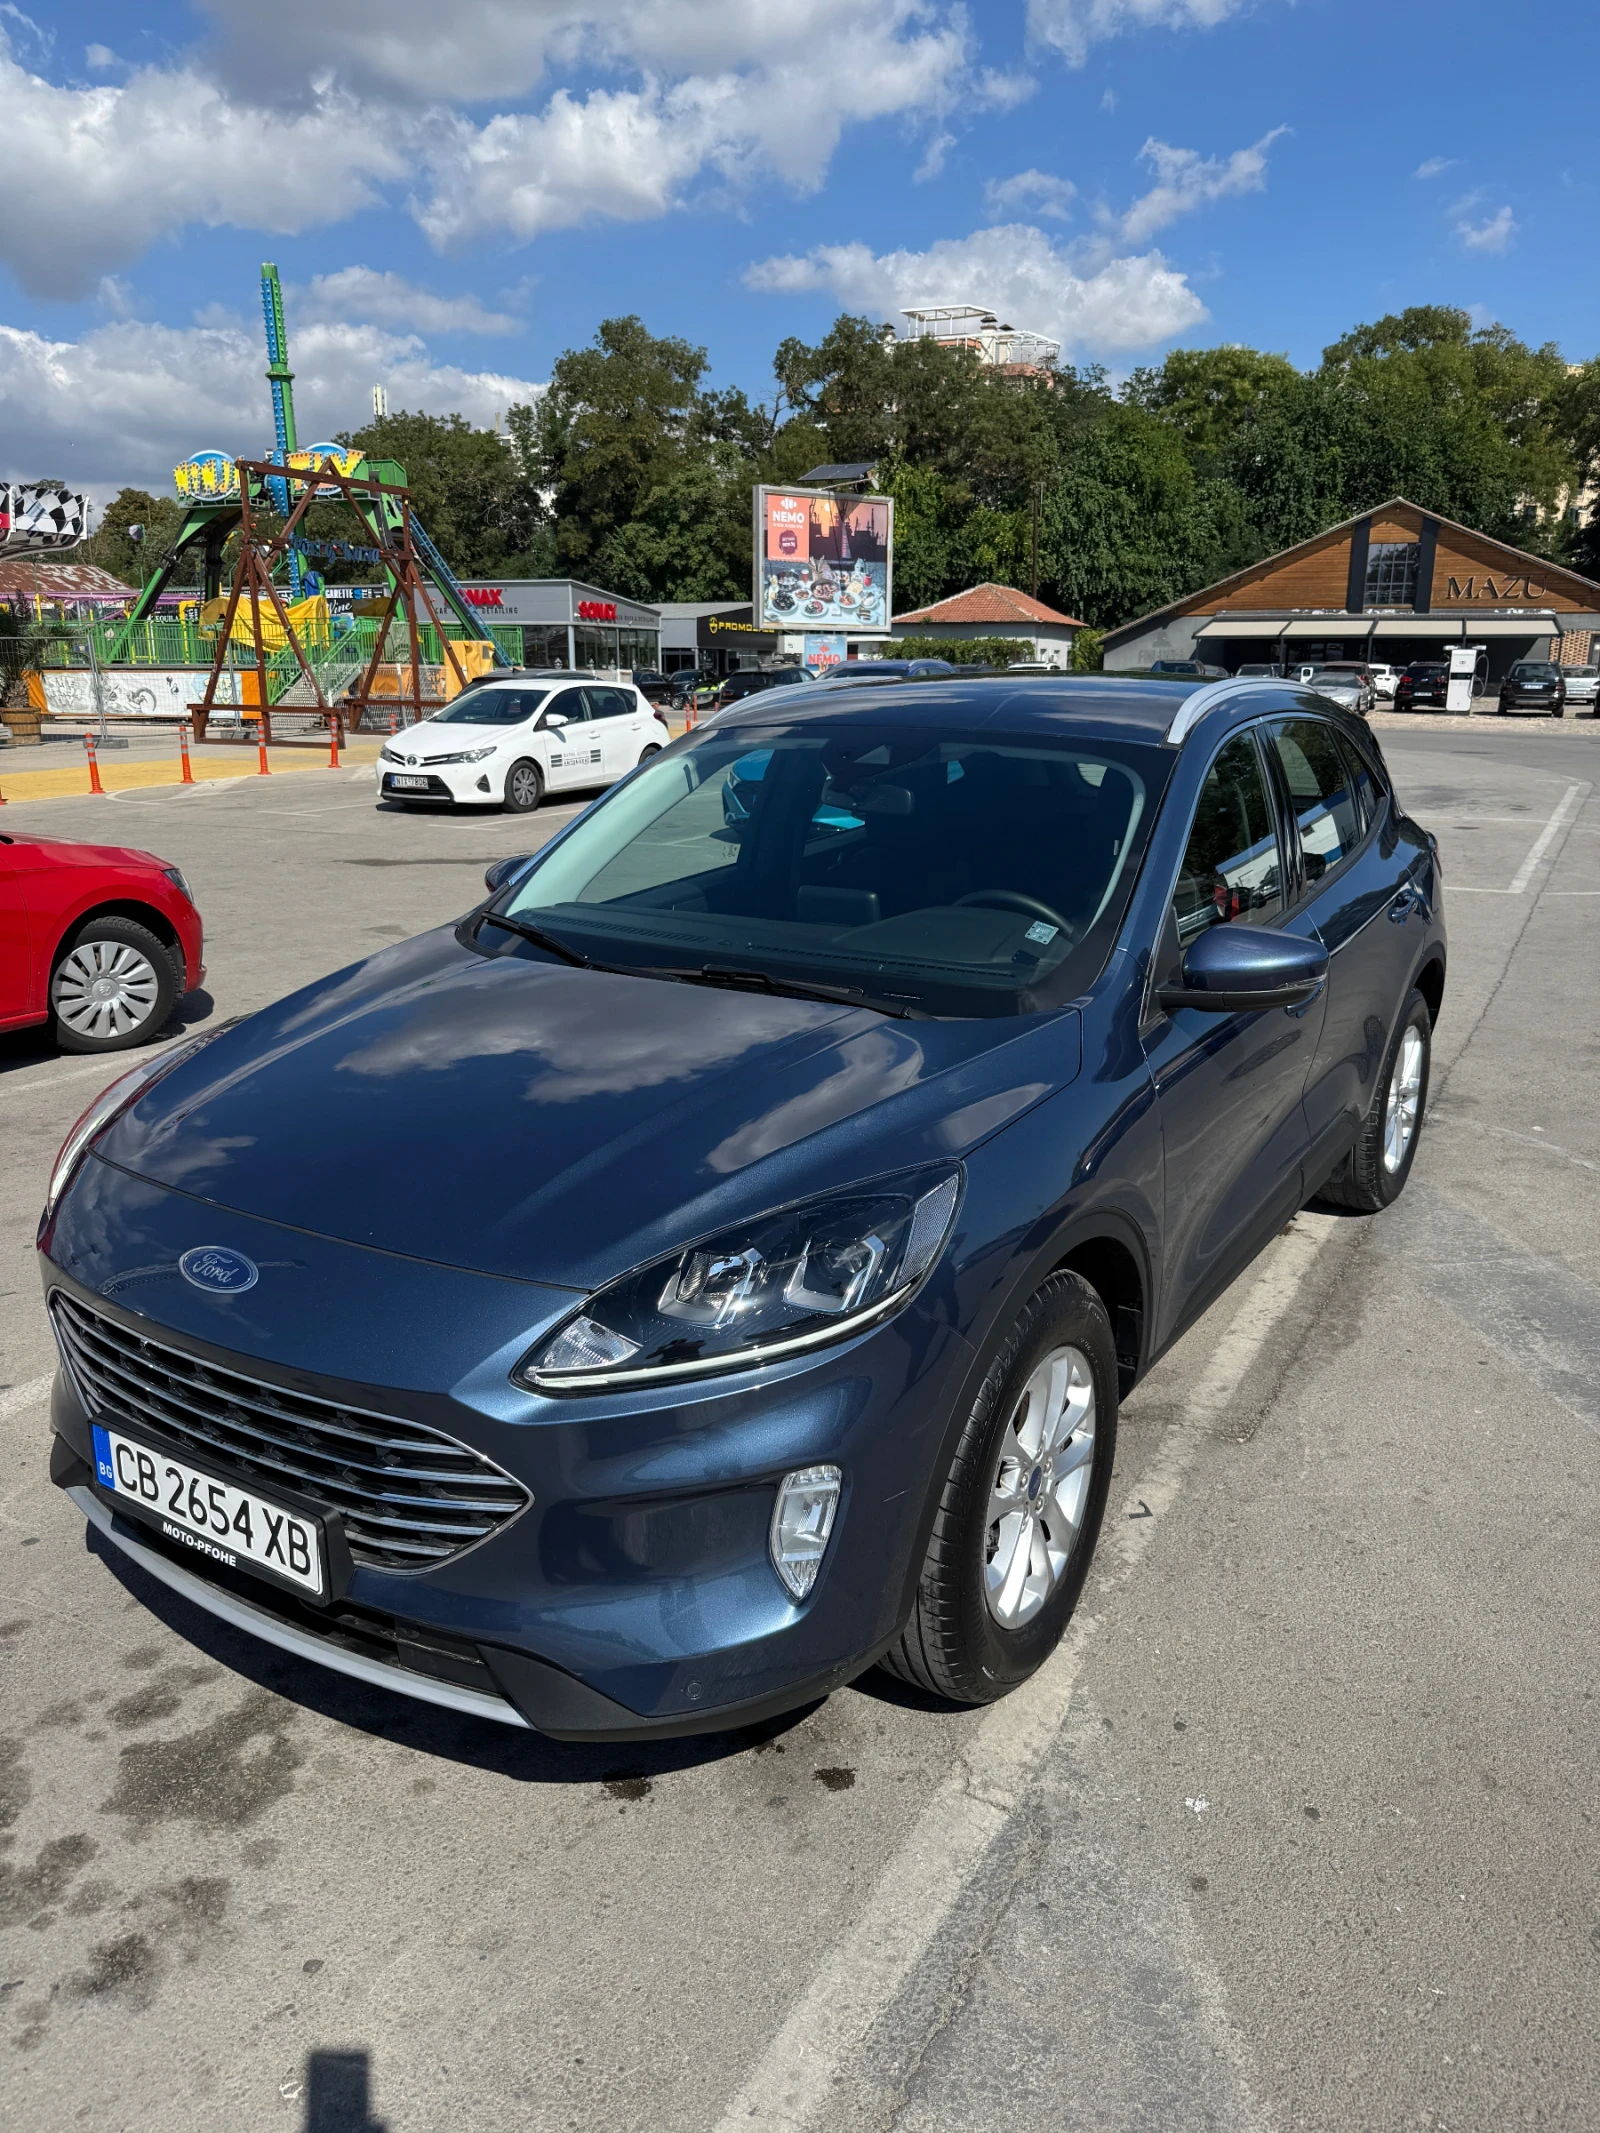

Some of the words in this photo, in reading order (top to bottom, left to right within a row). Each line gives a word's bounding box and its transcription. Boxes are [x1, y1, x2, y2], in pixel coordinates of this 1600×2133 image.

[772, 510, 805, 524] NEMO
[1446, 575, 1548, 600] MAZU
[578, 601, 617, 621] SONAX
[192, 1252, 239, 1283] Ford
[99, 1461, 113, 1479] BG
[115, 1443, 159, 1502] CB
[165, 1466, 254, 1550] 2654
[262, 1507, 311, 1576] XB
[162, 1521, 237, 1568] MOTO-PFOHE
